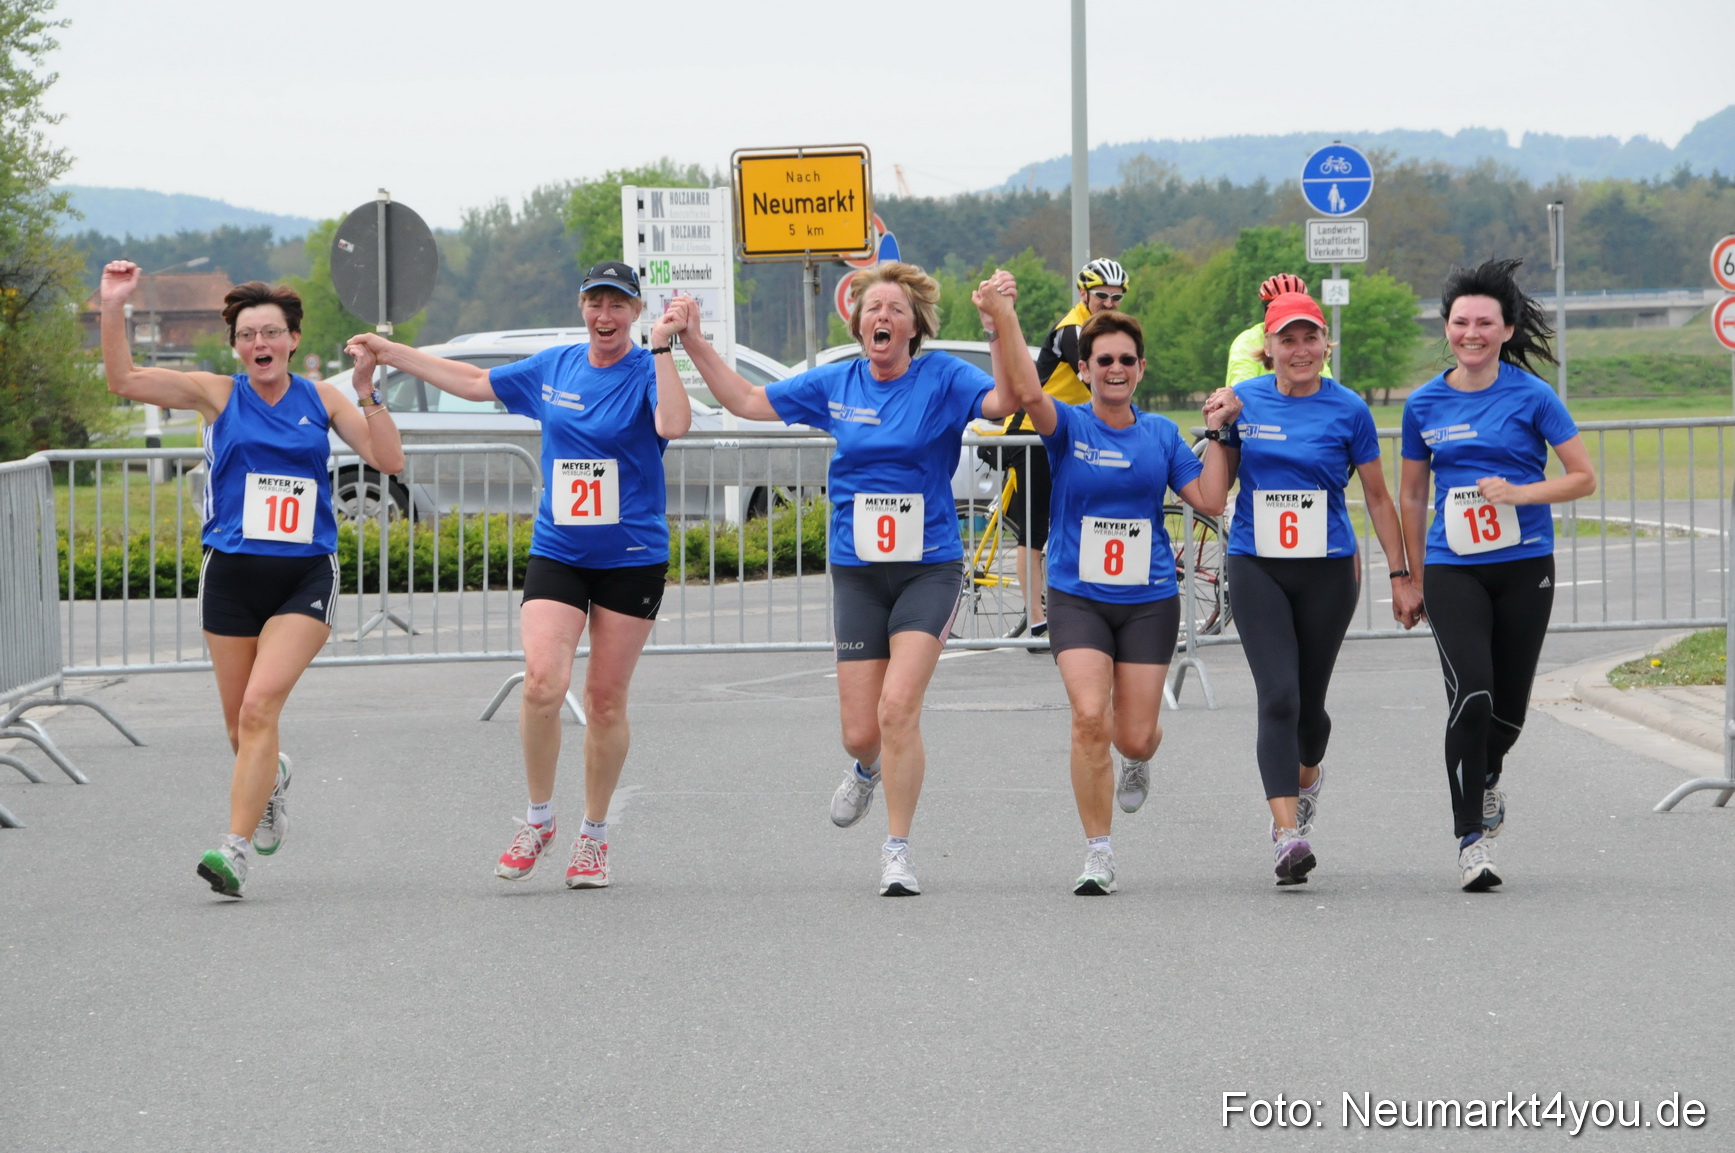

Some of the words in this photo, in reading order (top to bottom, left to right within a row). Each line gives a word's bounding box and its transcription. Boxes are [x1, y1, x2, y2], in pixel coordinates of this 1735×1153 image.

[785, 170, 821, 183] Nach
[669, 191, 710, 206] HOLZAMMER
[752, 189, 855, 216] Neumarkt
[670, 225, 711, 239] HOLZAMMER
[788, 223, 796, 236] 5
[807, 224, 824, 237] km
[1317, 225, 1357, 235] Landwirt-
[1313, 236, 1361, 246] schaftlicher
[1313, 247, 1344, 257] Verkehr
[1347, 246, 1362, 256] frei
[649, 259, 671, 286] SHB
[671, 263, 712, 281] Holzfachmarkt
[562, 462, 590, 470] MEYER
[561, 469, 591, 477] WERBUNG
[258, 477, 291, 487] MEYER
[258, 485, 291, 493] WERBUNG
[571, 479, 602, 517] 21
[865, 498, 897, 506] MEYER
[1265, 494, 1298, 502] MEYER
[1265, 500, 1299, 508] WERBUNG
[265, 495, 300, 534] 10
[1094, 521, 1127, 530] MEYER
[1279, 511, 1298, 549] 6
[1463, 504, 1501, 544] 13
[877, 514, 896, 553] 9
[1094, 528, 1127, 536] WERBUNG
[1104, 539, 1124, 576] 8
